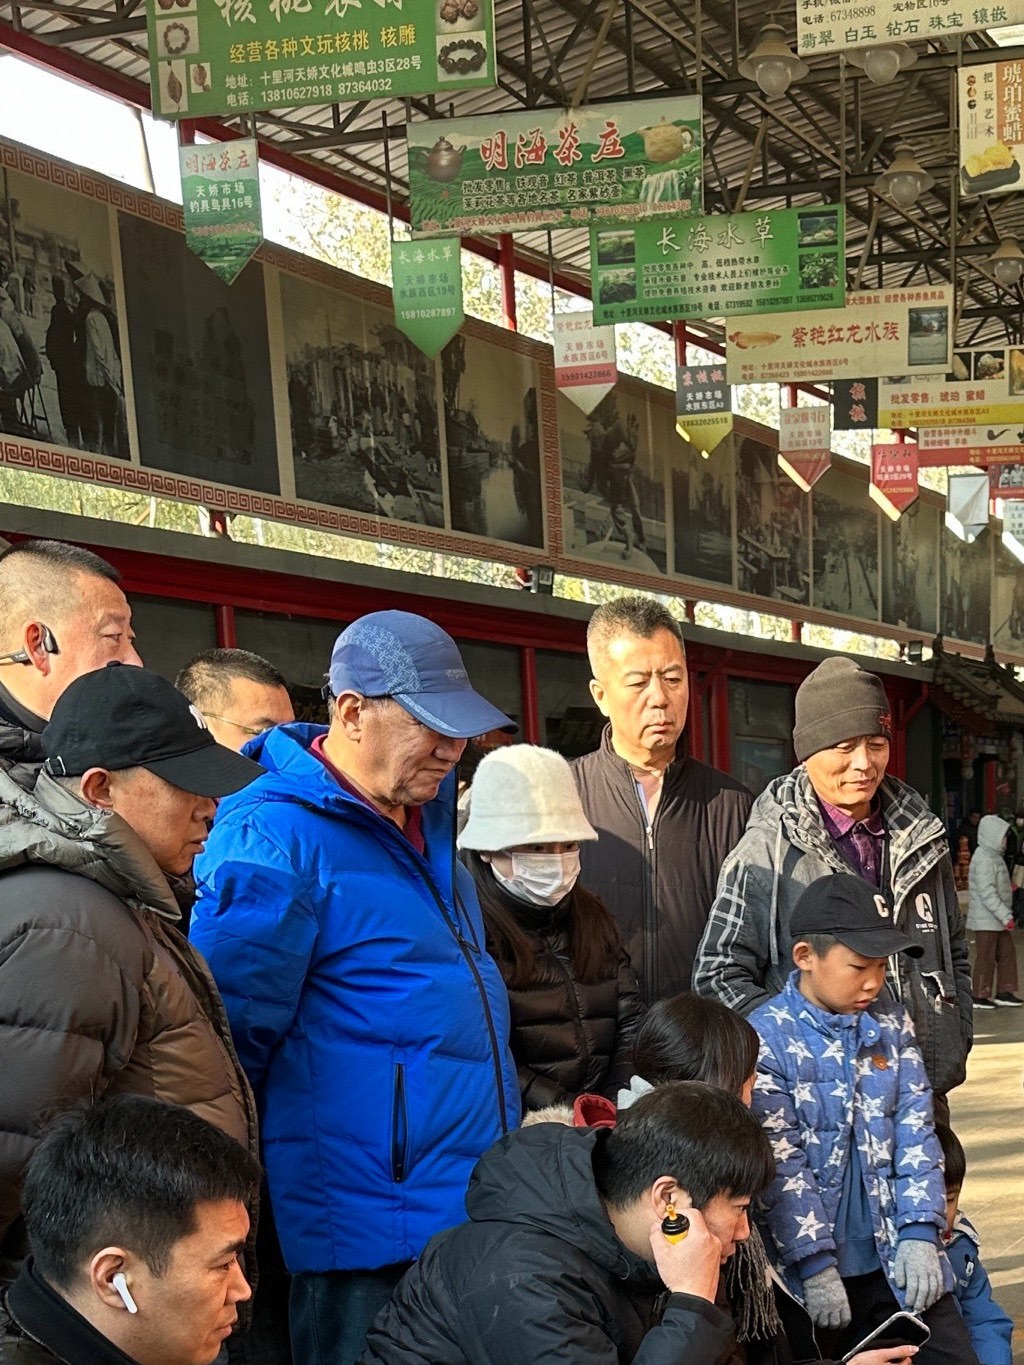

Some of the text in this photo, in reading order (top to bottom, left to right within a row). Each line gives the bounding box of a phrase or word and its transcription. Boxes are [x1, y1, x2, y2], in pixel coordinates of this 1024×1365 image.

[229, 24, 416, 64] 经营各种文玩核桃 核雕
[801, 6, 1008, 49] 翡翠 白玉 钻石 珠宝 镶嵌
[259, 55, 422, 85] 十里河天娇文化城鸣虫3区28号
[260, 85, 333, 103] 13810627918
[338, 79, 392, 95] 87364032
[1002, 63, 1022, 142] 琥珀蜜蜡
[480, 121, 626, 170] 明海茶庄
[196, 182, 245, 198] 天娇市场
[554, 173, 577, 187] 红茶
[190, 196, 253, 213] 钓具鸟具16号
[656, 216, 775, 255] 长海水草
